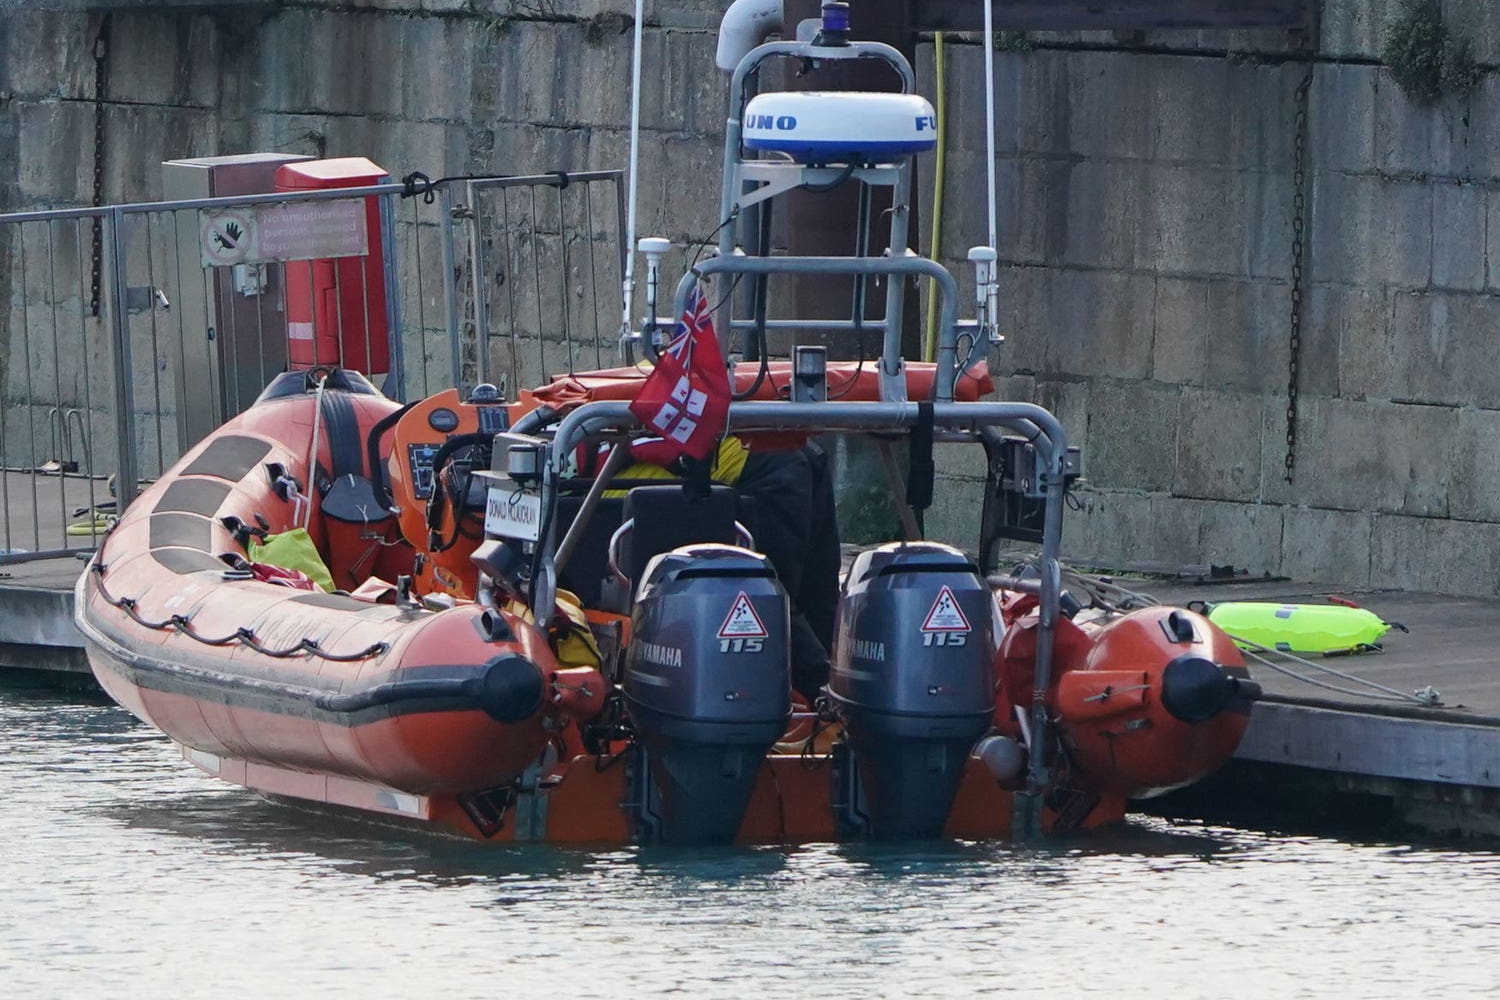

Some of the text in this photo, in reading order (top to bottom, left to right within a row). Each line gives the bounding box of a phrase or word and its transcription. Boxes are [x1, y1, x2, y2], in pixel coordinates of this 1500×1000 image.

[263, 213, 281, 224] No
[719, 638, 764, 654] 115
[922, 632, 968, 648] 115
[643, 643, 682, 668] YAMAHA
